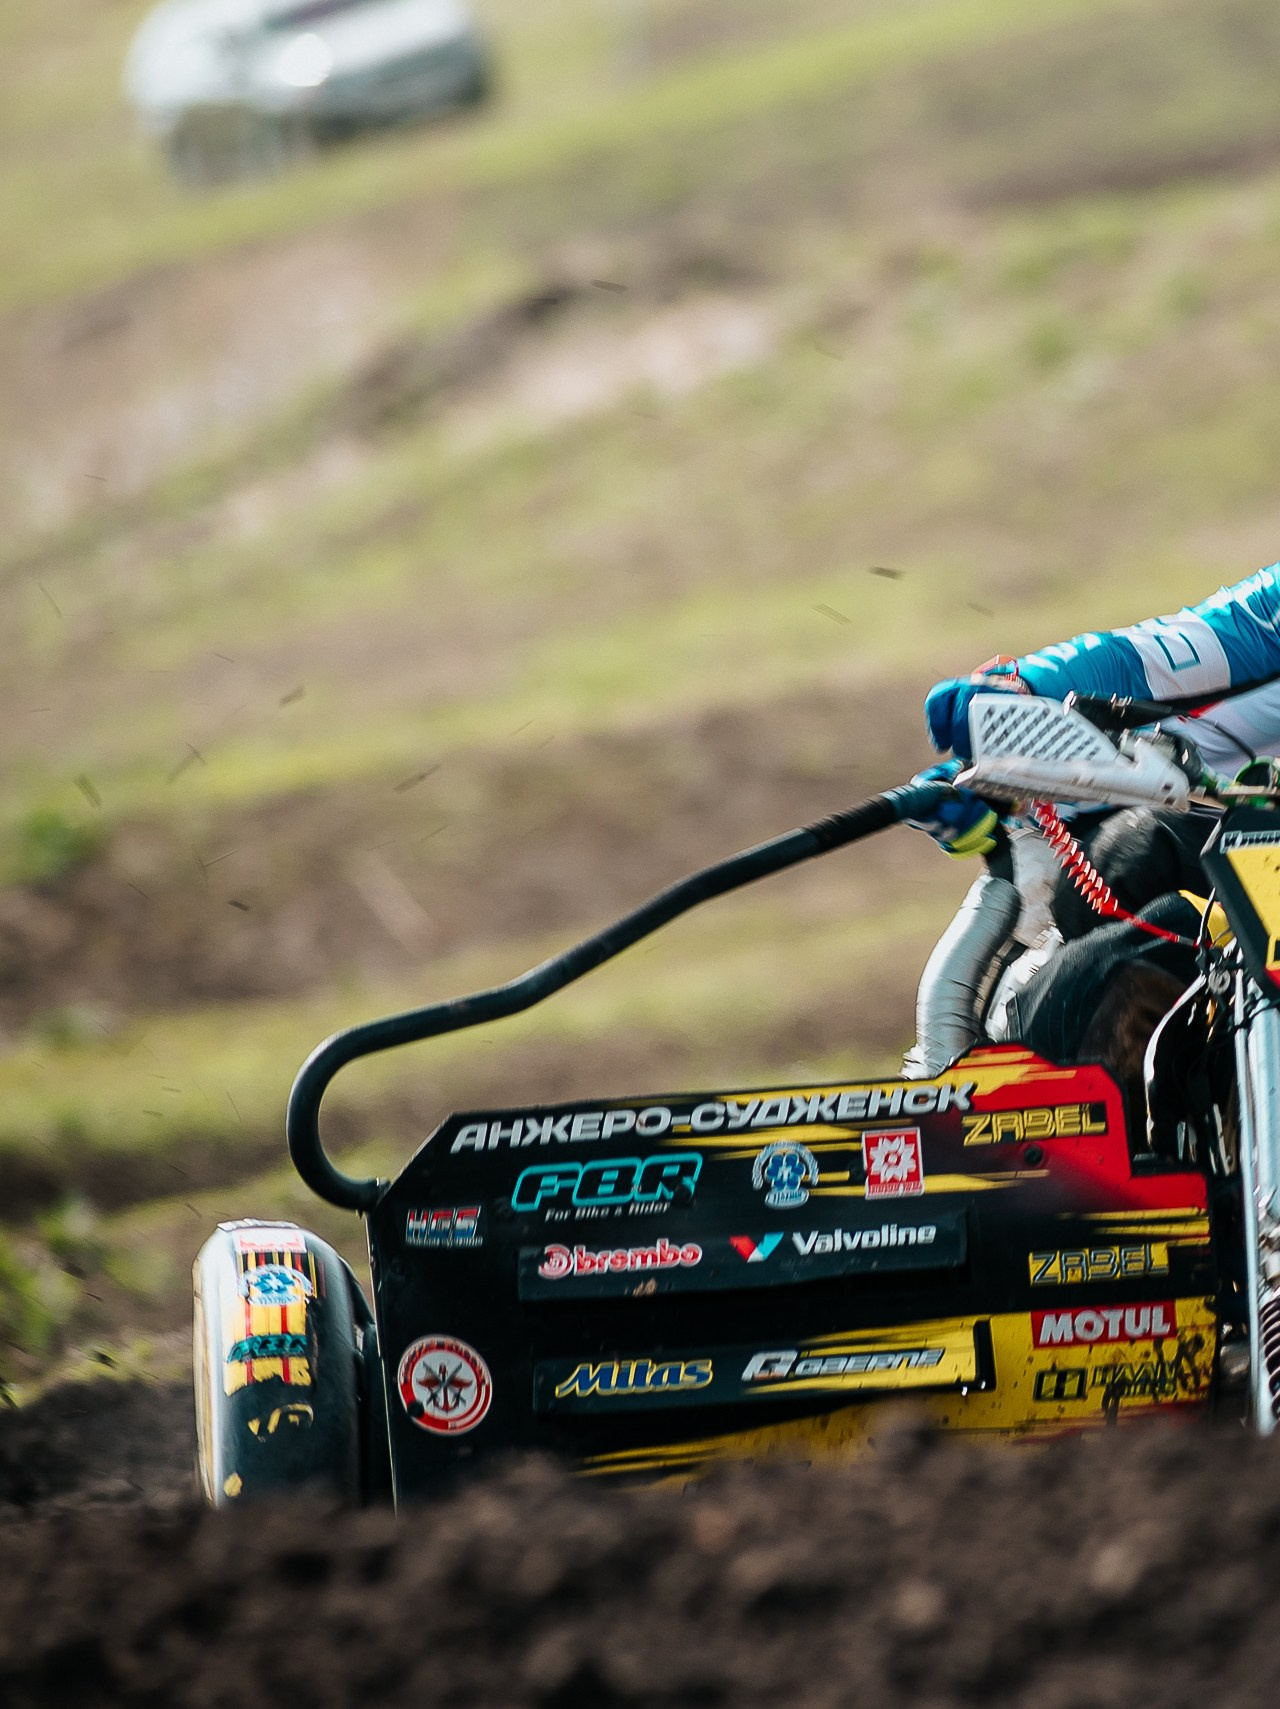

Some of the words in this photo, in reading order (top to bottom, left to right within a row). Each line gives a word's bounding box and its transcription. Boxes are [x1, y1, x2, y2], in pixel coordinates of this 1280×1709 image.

[450, 1082, 977, 1153] АНЖЕРО-СУДЖЕНСК
[962, 1103, 1106, 1147] ZABEL
[573, 1238, 702, 1276] brembo
[791, 1224, 937, 1256] Valvoline
[1030, 1244, 1168, 1286] ZABEL
[1039, 1306, 1170, 1345] MOTUL
